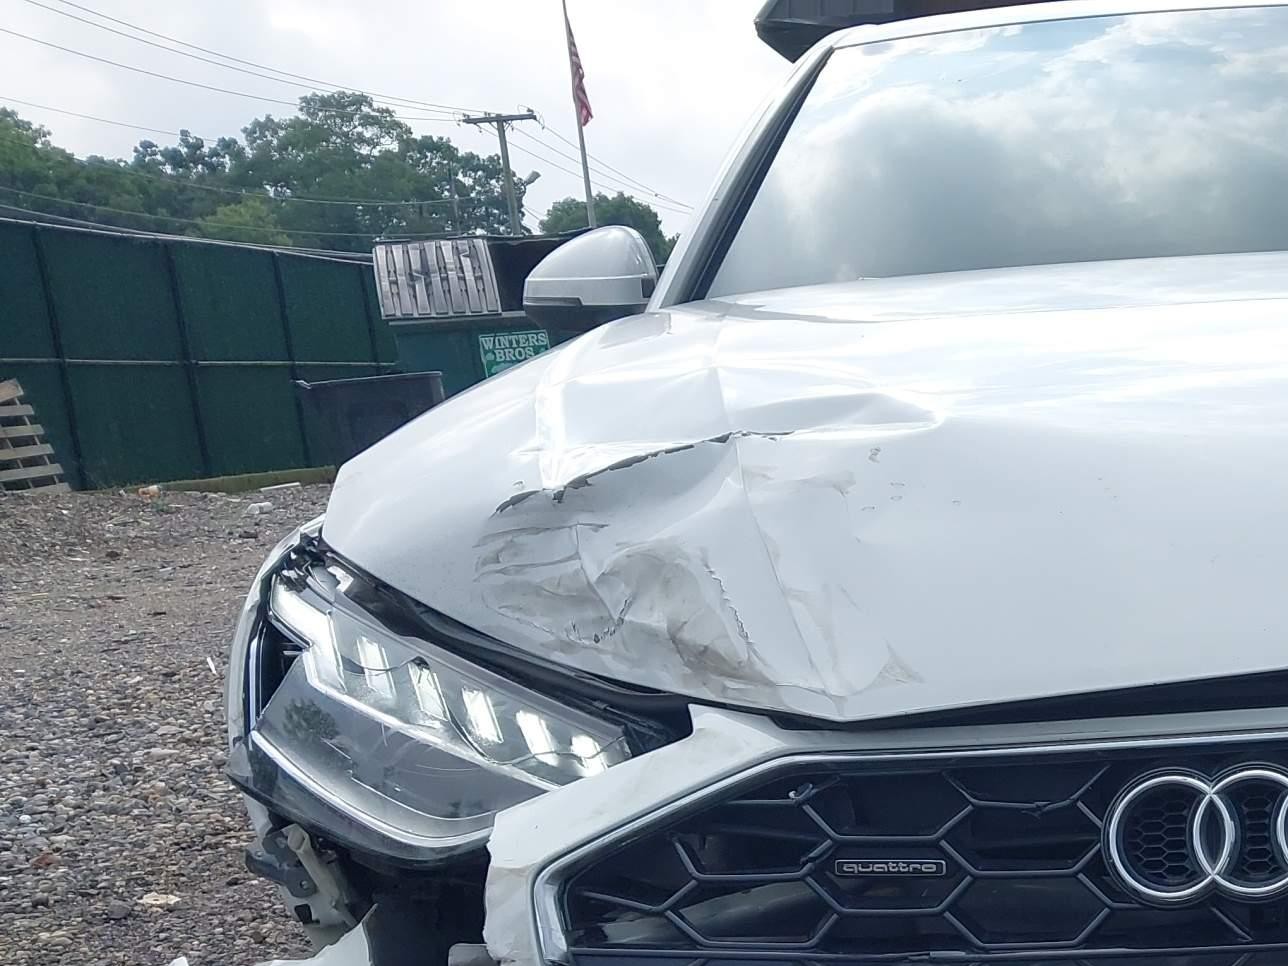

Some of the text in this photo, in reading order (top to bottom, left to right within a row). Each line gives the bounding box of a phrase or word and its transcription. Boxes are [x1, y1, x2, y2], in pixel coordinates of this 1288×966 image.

[480, 333, 547, 350] WINTERS
[494, 347, 535, 362] BROS
[842, 862, 937, 874] quattro
